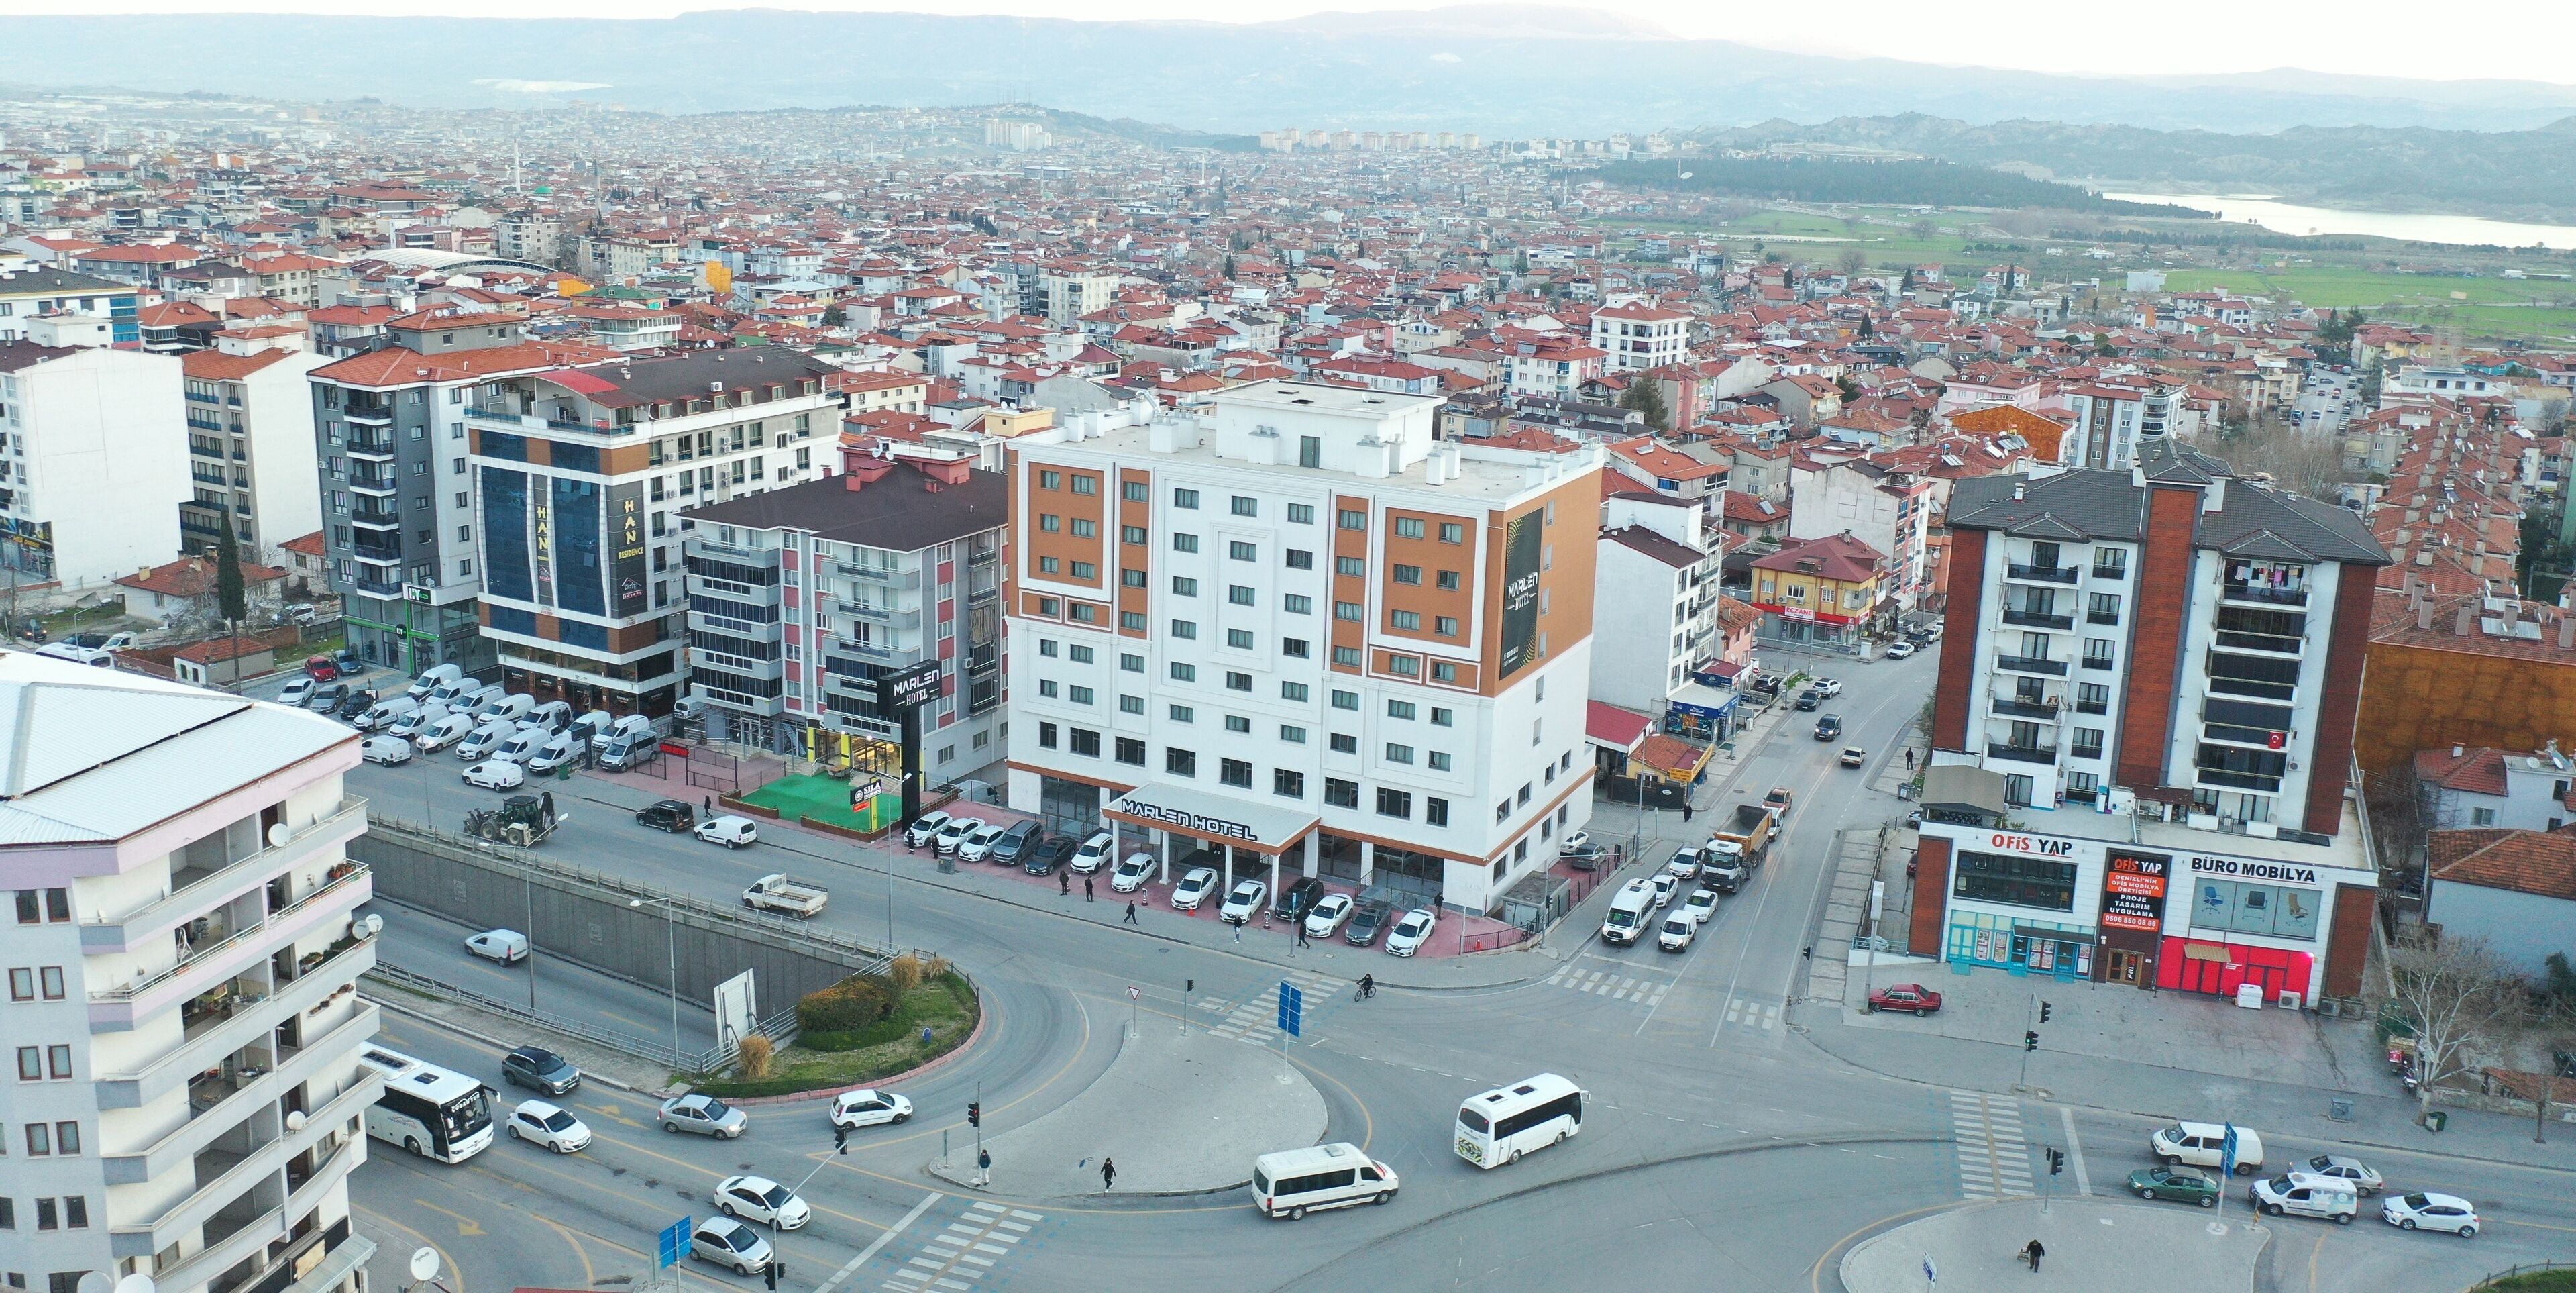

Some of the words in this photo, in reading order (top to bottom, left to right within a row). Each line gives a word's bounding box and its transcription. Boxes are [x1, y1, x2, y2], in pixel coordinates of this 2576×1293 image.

[537, 506, 548, 550] HAN
[625, 500, 637, 545] HAN
[619, 546, 643, 560] RESIDENCE
[1507, 572, 1538, 600] MARLEN
[1514, 592, 1529, 611] HOTEL
[1786, 607, 1812, 616] ECZANE
[894, 669, 939, 696] MARLEN
[906, 688, 928, 706] HOTEL
[1122, 798, 1191, 827] MARLEN
[1193, 815, 1258, 841] HOTEL
[2038, 839, 2072, 856] YAP
[2141, 862, 2162, 874] YAP
[2191, 856, 2238, 874] BÜRO
[2241, 863, 2316, 882] MOBİLYA
[2115, 900, 2150, 910] TASARIM
[2121, 894, 2147, 902] PROJE
[2106, 915, 2122, 923] 0506
[2110, 907, 2153, 917] UYGULAMA
